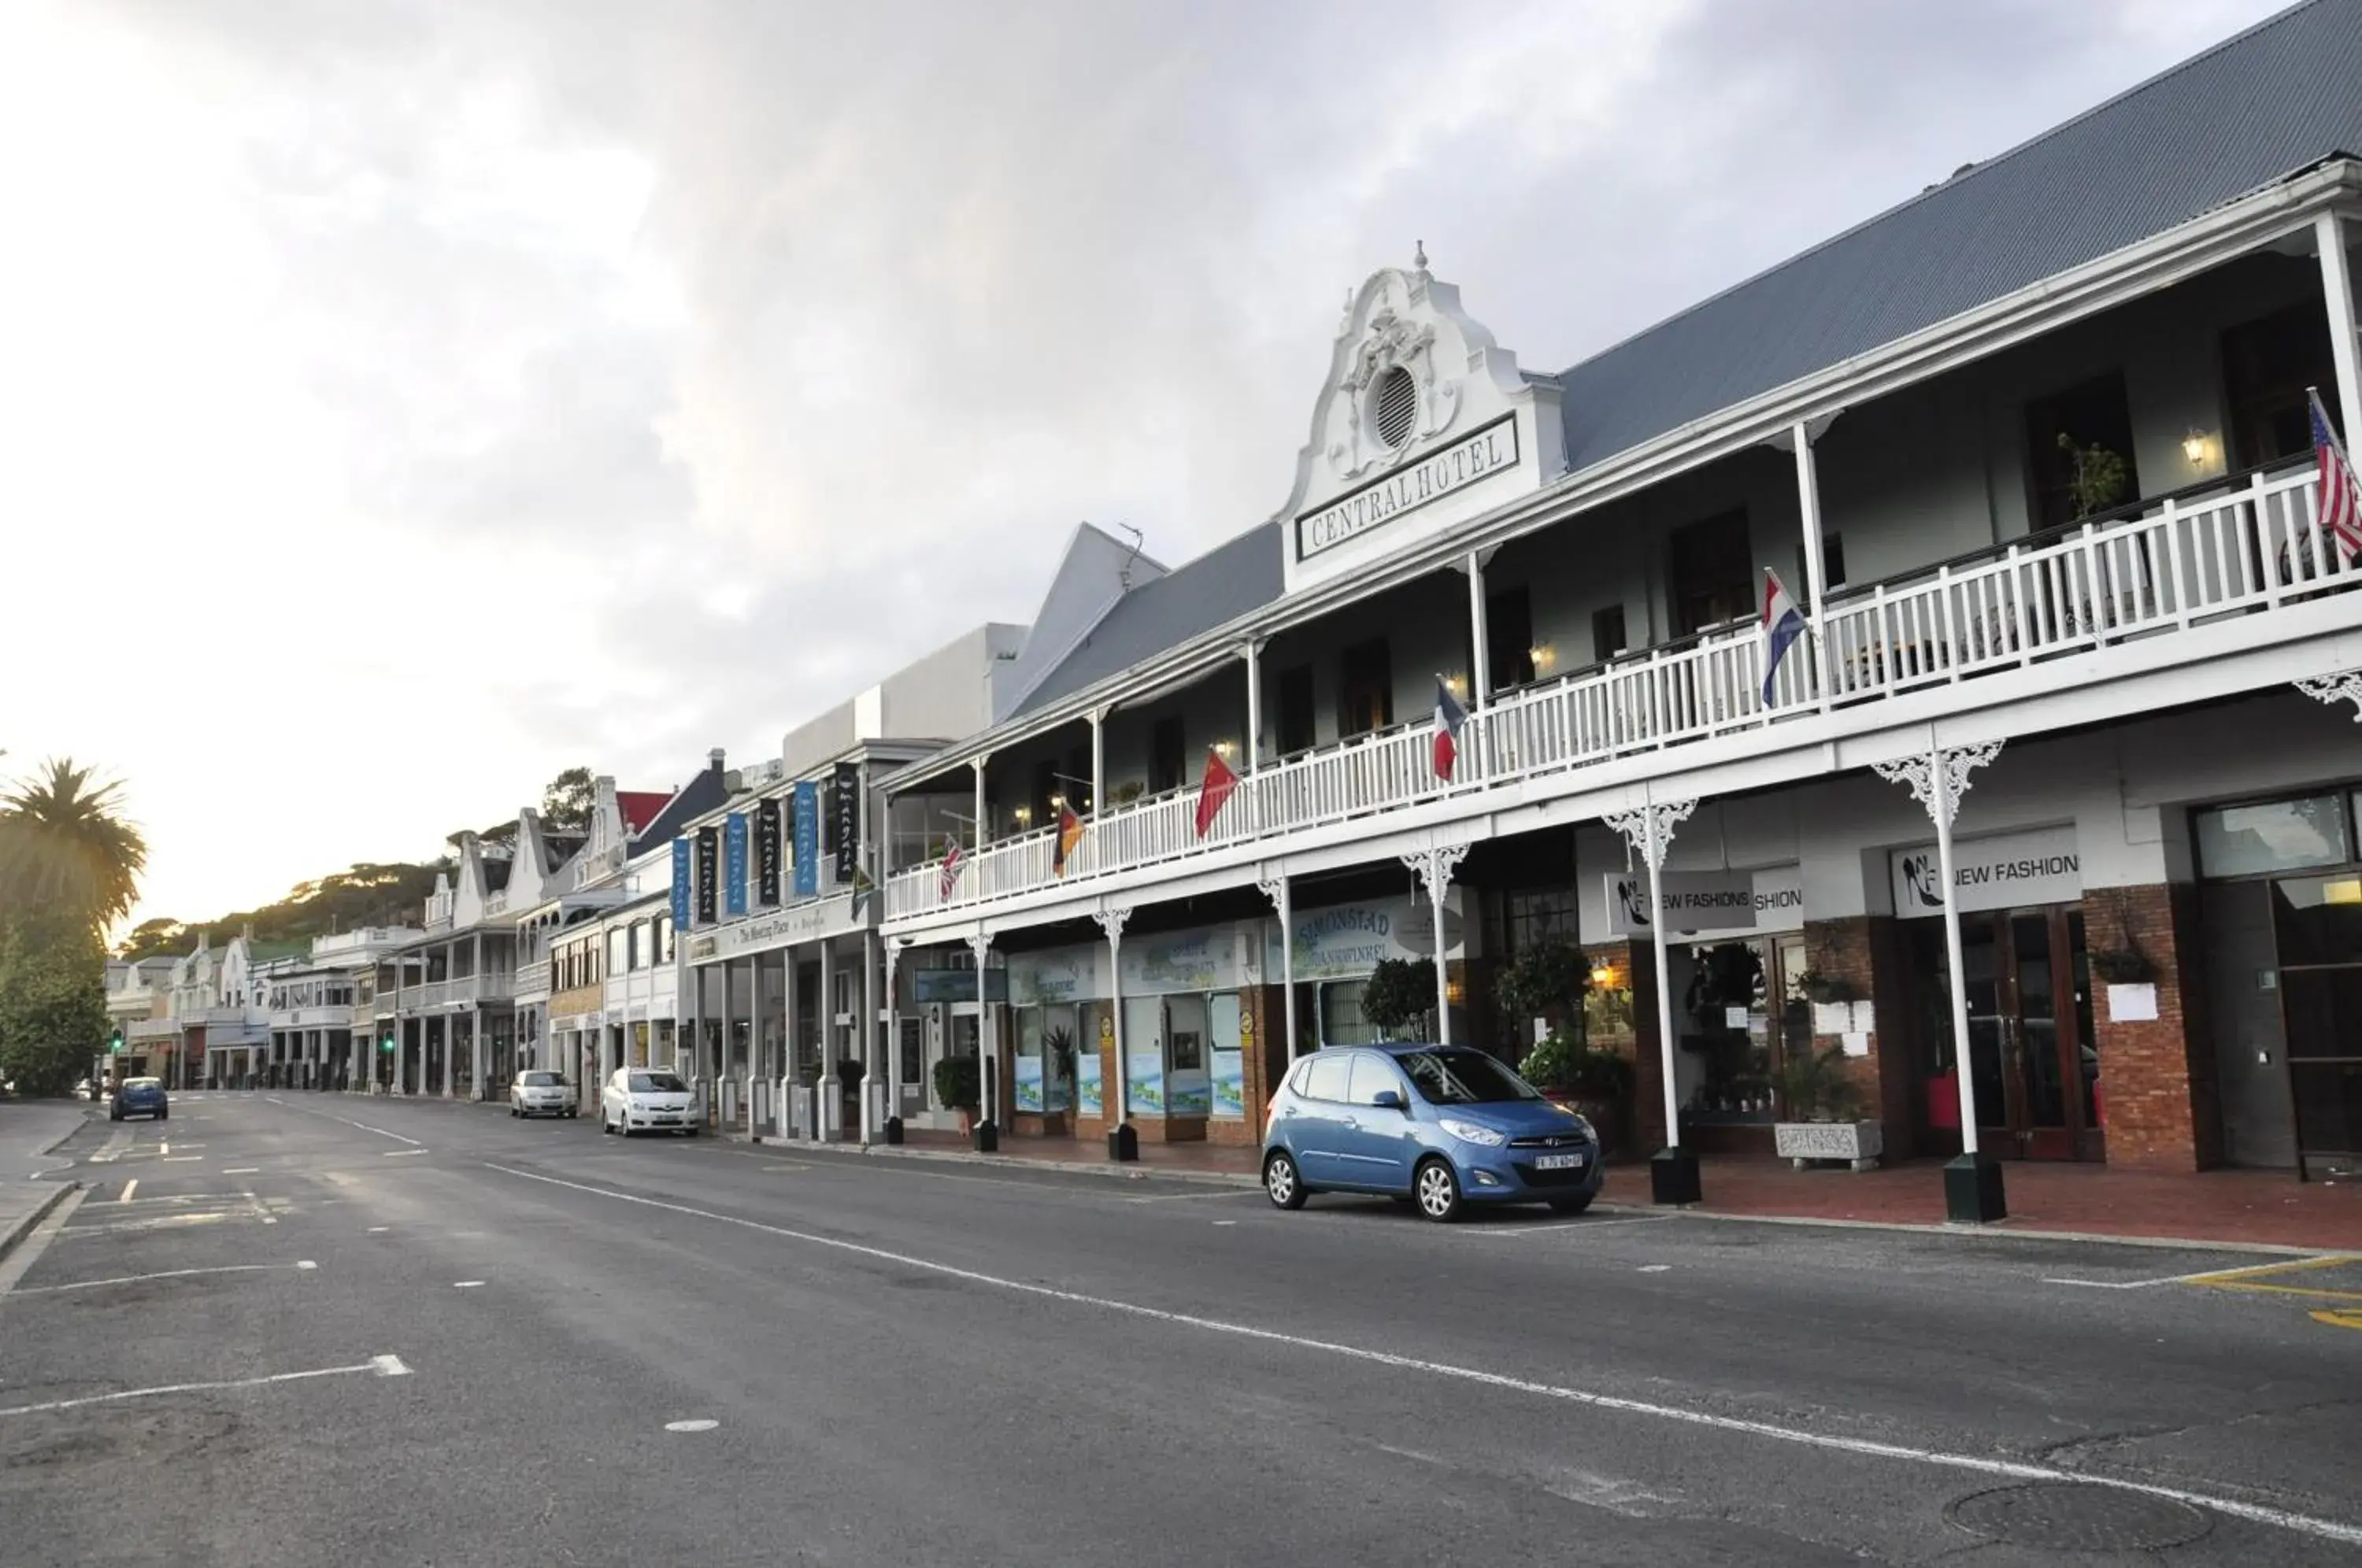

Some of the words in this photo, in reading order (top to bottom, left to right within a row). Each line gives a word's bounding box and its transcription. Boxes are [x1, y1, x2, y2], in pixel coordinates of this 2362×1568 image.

[1312, 474, 1412, 549] CENTRAL
[1416, 434, 1503, 499] HOTEL
[1996, 854, 2079, 881] FASHION
[1649, 894, 1683, 910] EW
[1686, 891, 1749, 909] FASHIONS
[1754, 889, 1802, 911] SHION
[1299, 908, 1390, 939] SIMONSTAD
